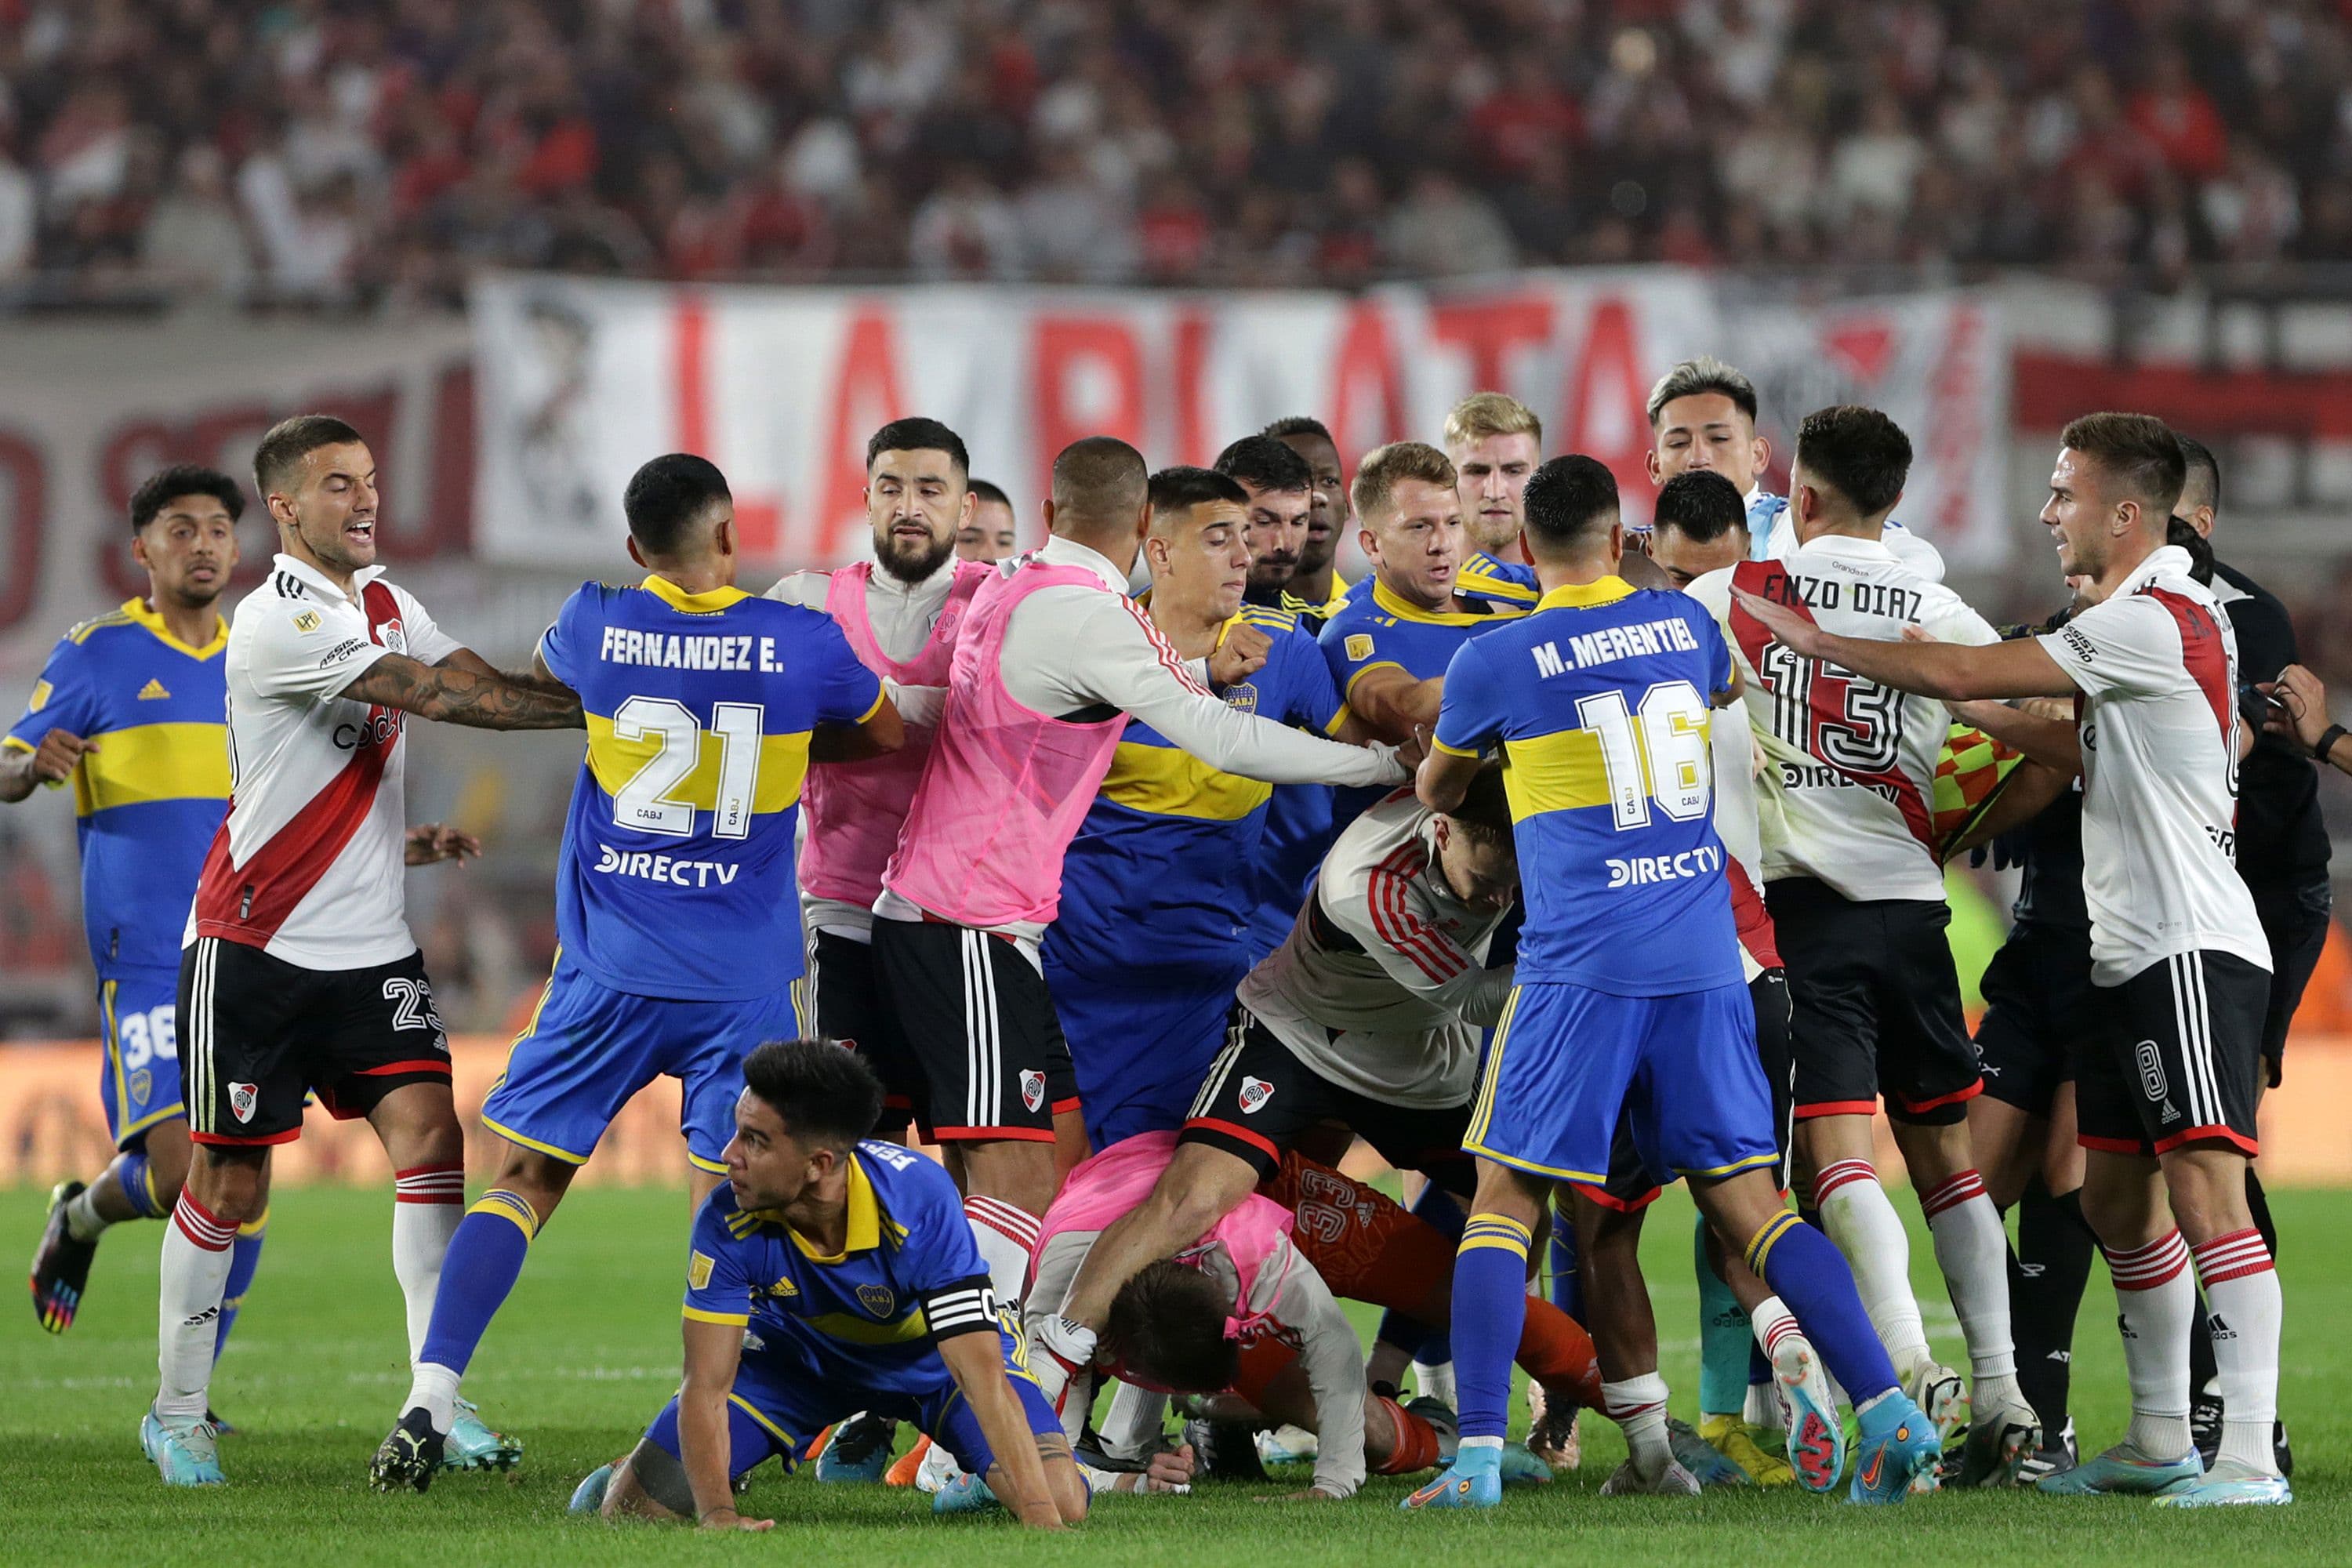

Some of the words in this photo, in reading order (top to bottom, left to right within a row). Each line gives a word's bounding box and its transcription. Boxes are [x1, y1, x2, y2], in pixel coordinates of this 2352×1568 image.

[1764, 574, 1839, 609] ENZO
[1853, 583, 1922, 623] DIAZ
[601, 626, 753, 671] FERNANDEZ
[759, 637, 783, 673] E.
[1761, 641, 1906, 775] 13
[613, 695, 764, 840] 21
[1574, 680, 1711, 832] 16
[637, 808, 662, 820] CABJ
[728, 798, 741, 826] CABJ
[1624, 787, 1635, 815] CABJ
[593, 844, 739, 887] DIRECTV
[1606, 846, 1719, 887] DIRECTV
[2136, 1040, 2168, 1102] 8
